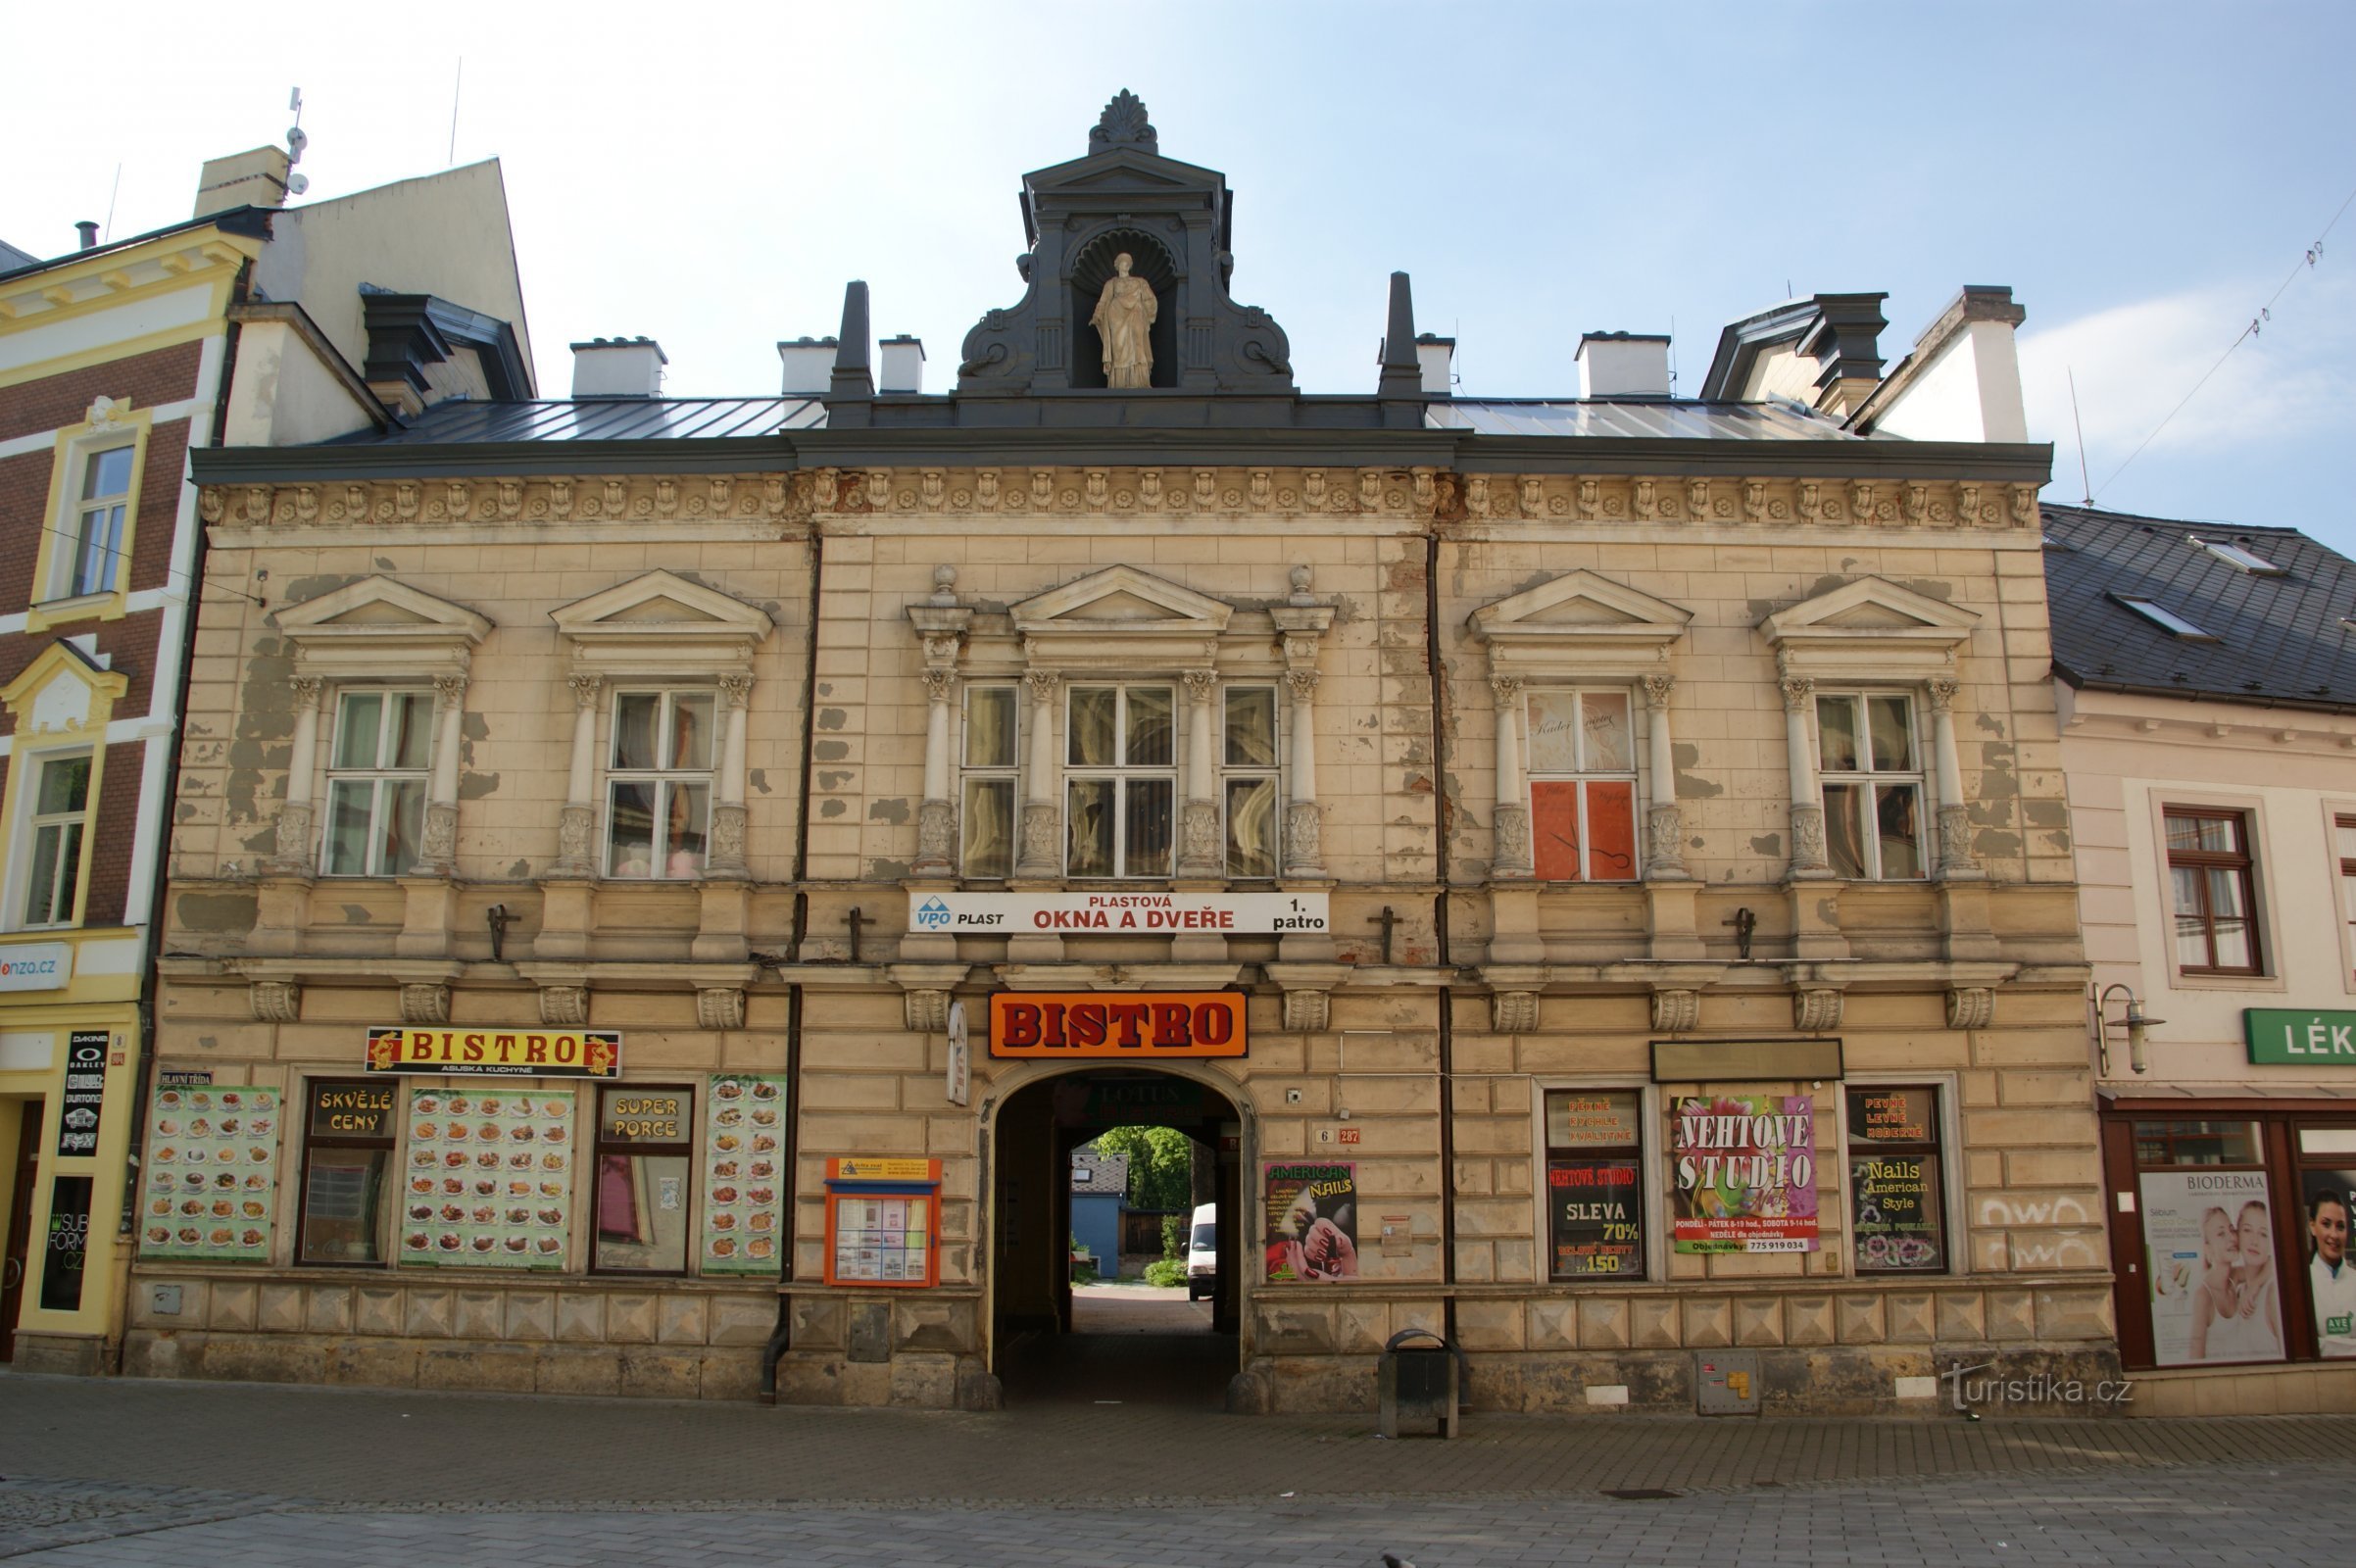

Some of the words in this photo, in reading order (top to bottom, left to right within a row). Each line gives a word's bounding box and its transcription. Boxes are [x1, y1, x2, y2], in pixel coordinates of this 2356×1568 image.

[1089, 894, 1172, 907] PLASTOVÁ
[1290, 899, 1306, 912] 1.
[917, 912, 951, 925] VPO
[957, 913, 1004, 925] PLAST
[1033, 909, 1109, 929] OKNA
[1119, 910, 1137, 928] A
[1146, 906, 1234, 929] DVEŘE
[1273, 915, 1324, 931] patro
[1002, 1003, 1233, 1048] BISTRO
[411, 1032, 576, 1063] BISTRO
[162, 1073, 188, 1084] HLAVNÍ
[188, 1073, 211, 1085] TŘÍDA
[320, 1090, 392, 1110] SKVĚLÉ
[615, 1099, 677, 1115] SUPER
[1569, 1098, 1611, 1112] PĚKNĚ
[1865, 1094, 1906, 1108] PEVNĚ
[330, 1114, 378, 1131] CENY
[1569, 1116, 1619, 1127] RYCHLE
[1866, 1108, 1907, 1124] LEVNĚ
[614, 1120, 677, 1137] PORCE
[1677, 1102, 1810, 1149] NEHTOVÉ
[1866, 1123, 1922, 1138] MODERNĚ
[1321, 1131, 1328, 1142] 6
[1341, 1130, 1358, 1142] 287
[1569, 1128, 1632, 1142] KVALITNĚ
[1268, 1165, 1350, 1179] AMERICAN
[1549, 1166, 1595, 1187] NEHTOVÉ
[1596, 1167, 1635, 1186] STUDIO
[1678, 1154, 1811, 1190] STUDIO
[1867, 1161, 1920, 1180] Nails
[1309, 1179, 1352, 1199] NAILS
[1866, 1182, 1929, 1194] American
[2186, 1176, 2265, 1190] BIODERMA
[1566, 1202, 1626, 1220] SLEVA
[1883, 1198, 1915, 1211] Style
[61, 1213, 89, 1232] SUB
[1708, 1219, 1730, 1228] PÁTEK
[1762, 1219, 1789, 1228] SOBOTA
[1602, 1223, 1639, 1240] 70%
[1710, 1229, 1737, 1239] NEDĚLE
[1747, 1231, 1784, 1240] objednávky
[48, 1232, 87, 1250] FORM
[1693, 1242, 1747, 1251] Objednávky:
